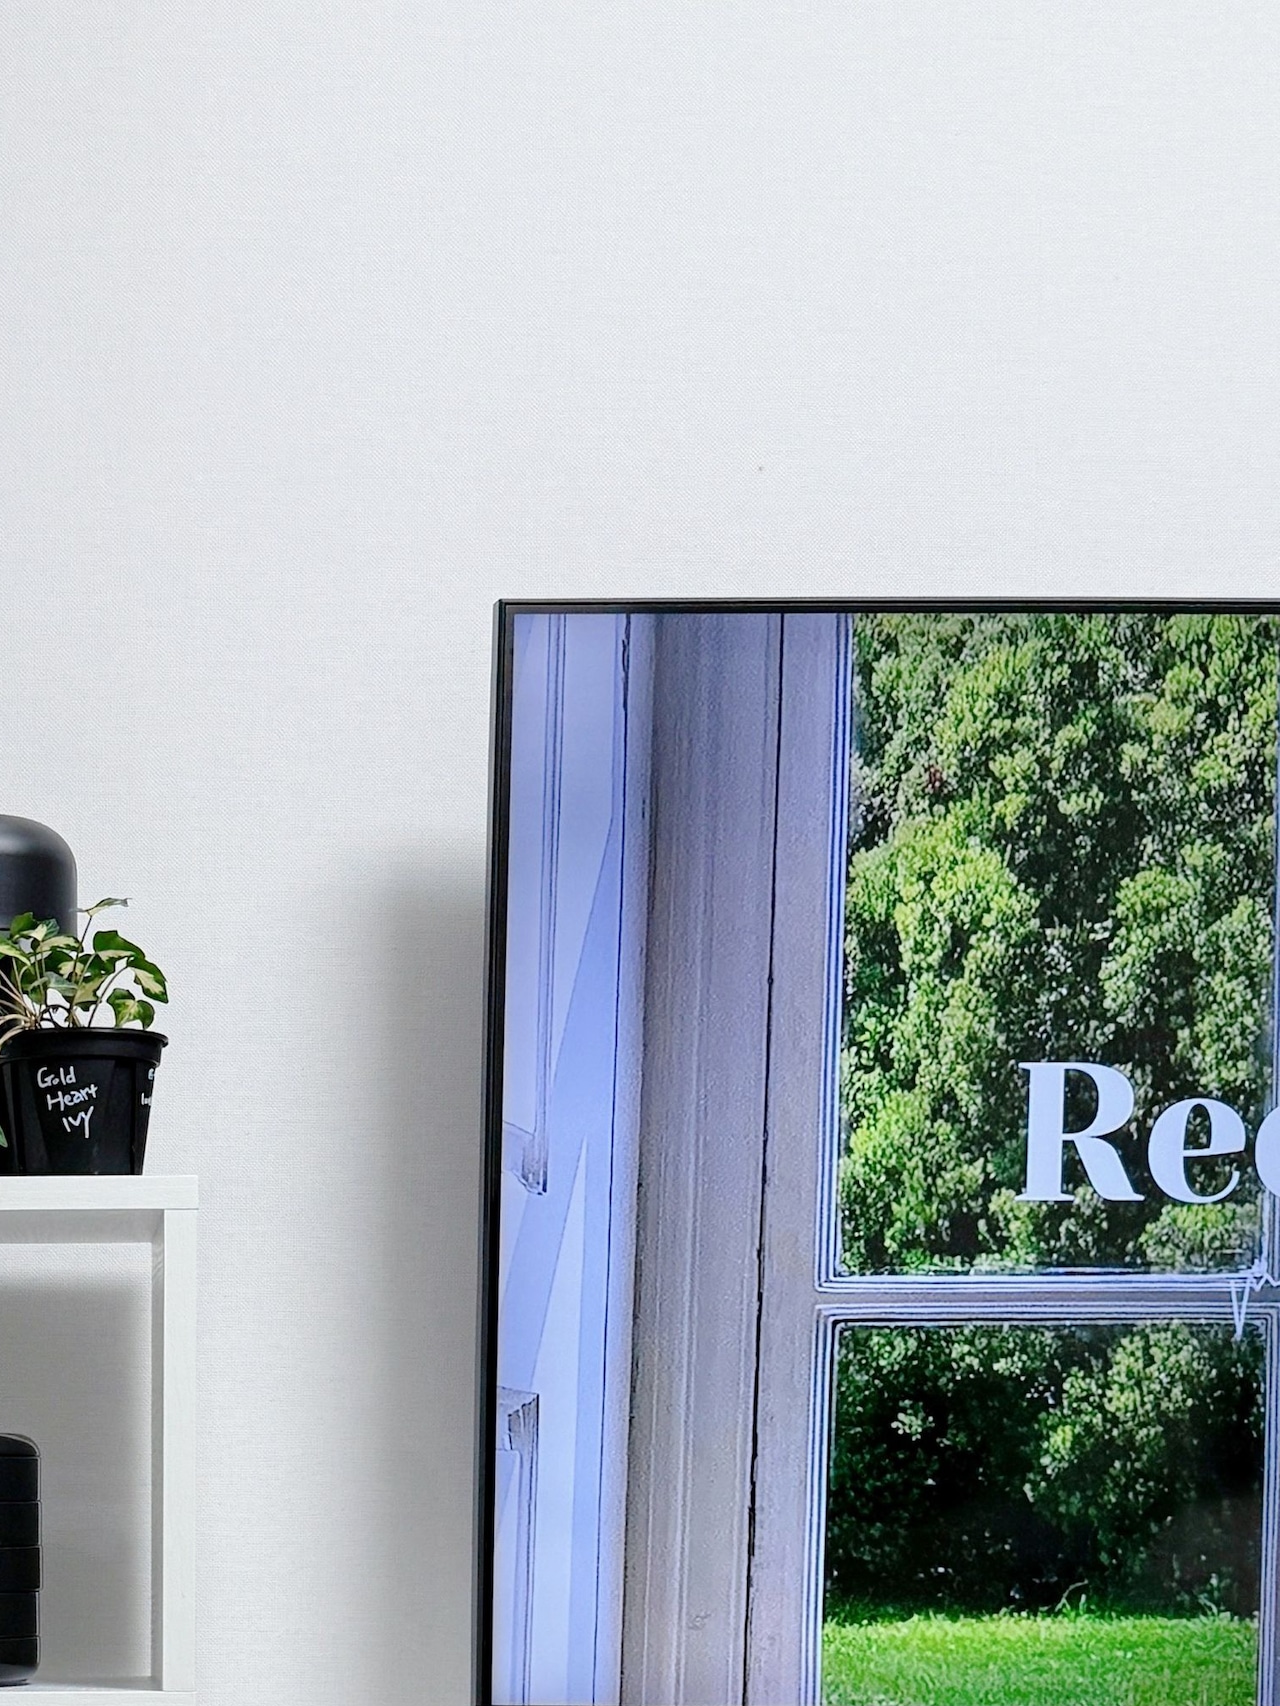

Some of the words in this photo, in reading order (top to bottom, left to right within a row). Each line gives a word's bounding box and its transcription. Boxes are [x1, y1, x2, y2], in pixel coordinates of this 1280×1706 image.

[37, 1066, 76, 1088] Gold
[46, 1083, 99, 1111] Heart
[1014, 1061, 1280, 1204] Re
